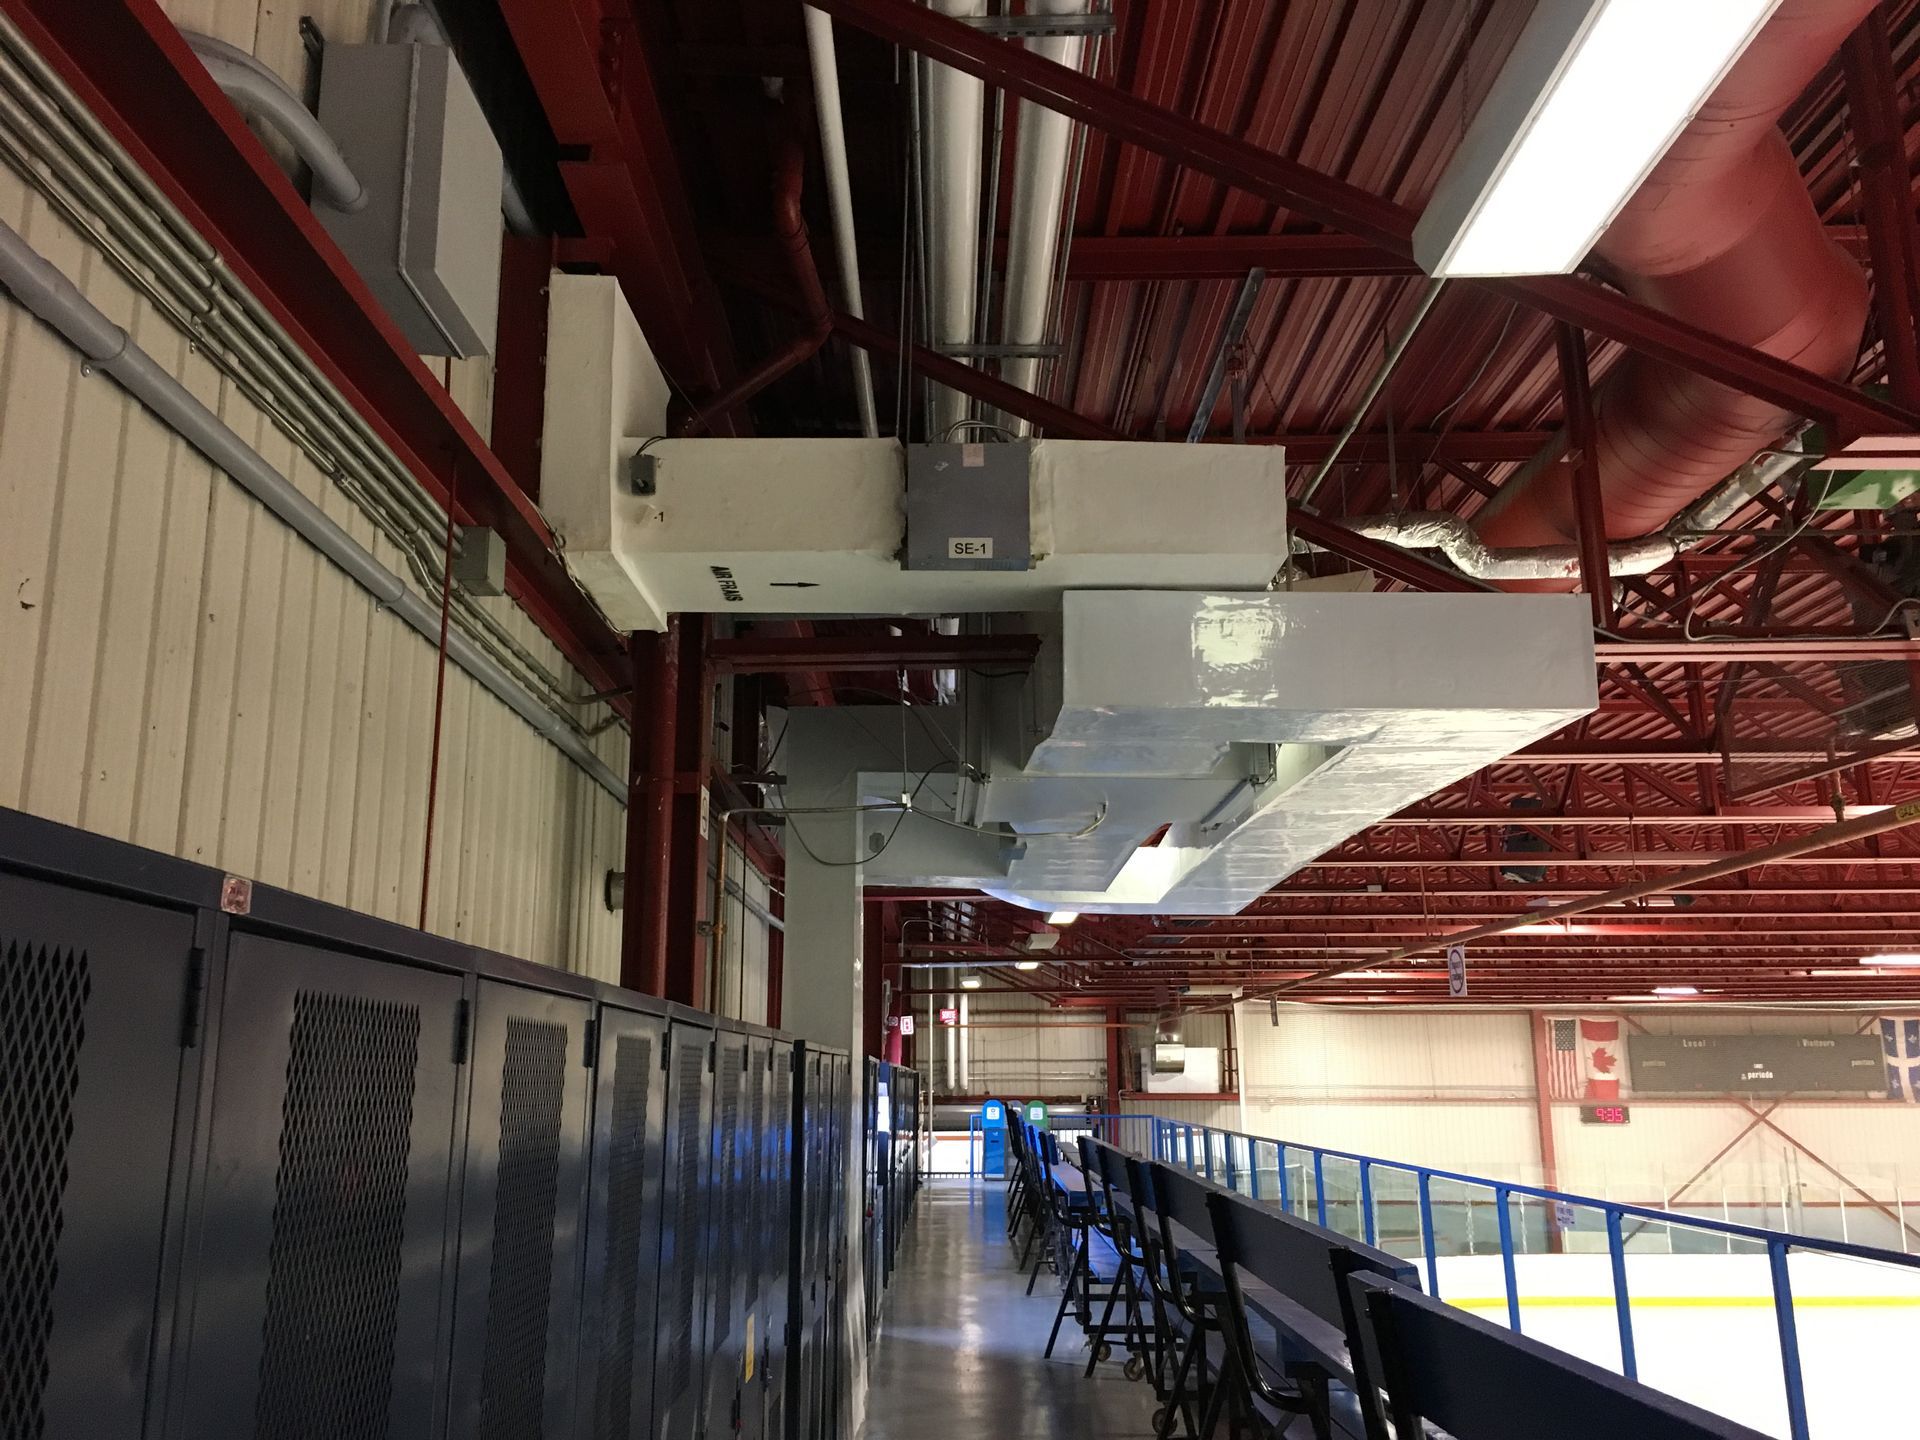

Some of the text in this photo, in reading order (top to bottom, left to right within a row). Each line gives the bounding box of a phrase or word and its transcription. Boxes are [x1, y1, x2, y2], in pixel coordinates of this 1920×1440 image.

[954, 543, 986, 554] SE-1
[710, 566, 744, 601] AIR FRAIS
[1596, 1108, 1623, 1122] 9:35
